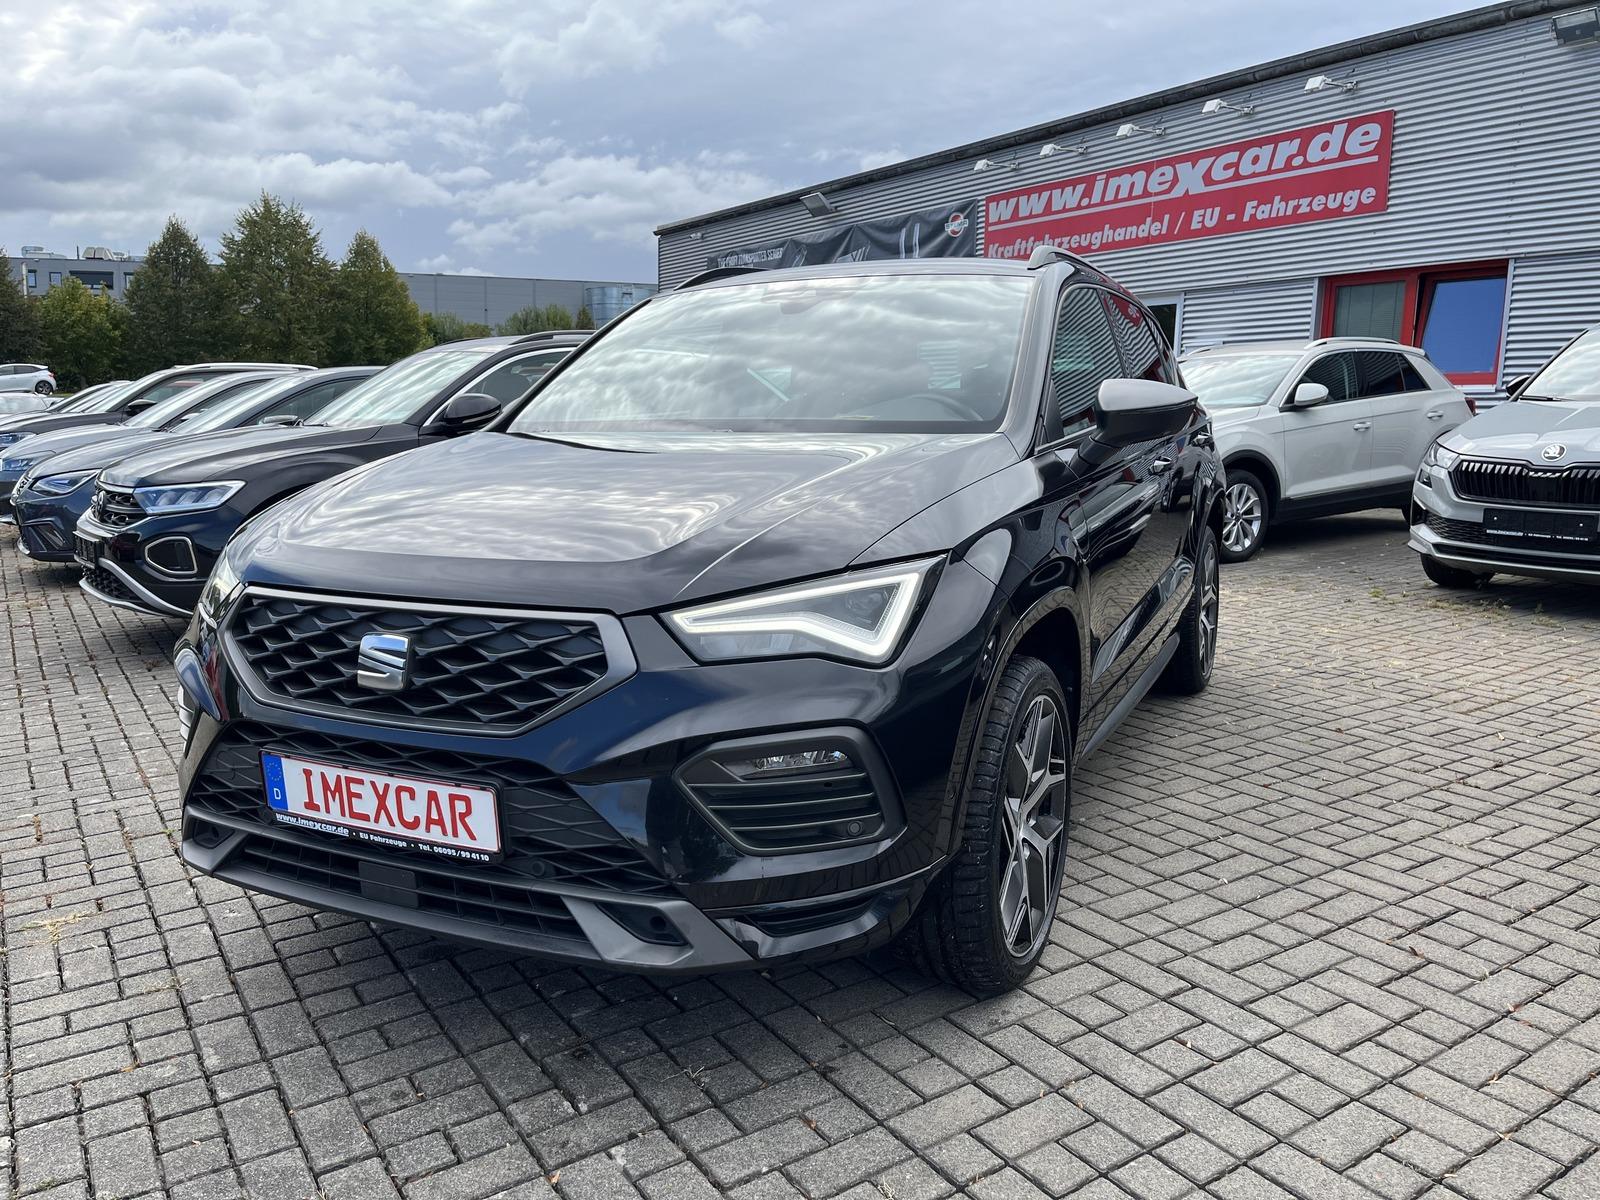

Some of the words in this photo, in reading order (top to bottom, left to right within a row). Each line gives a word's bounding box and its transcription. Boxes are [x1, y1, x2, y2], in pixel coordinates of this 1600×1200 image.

[987, 121, 1382, 223] www.imexcar.de
[1190, 208, 1220, 231] EU
[1243, 186, 1377, 222] Fahrzeuge
[274, 788, 281, 799] D
[302, 768, 477, 841] IMEXCAR
[275, 813, 349, 836] www.imexcar.de
[359, 832, 369, 840] EU
[370, 834, 407, 848] Fahrzeuge
[418, 843, 432, 852] Tel.
